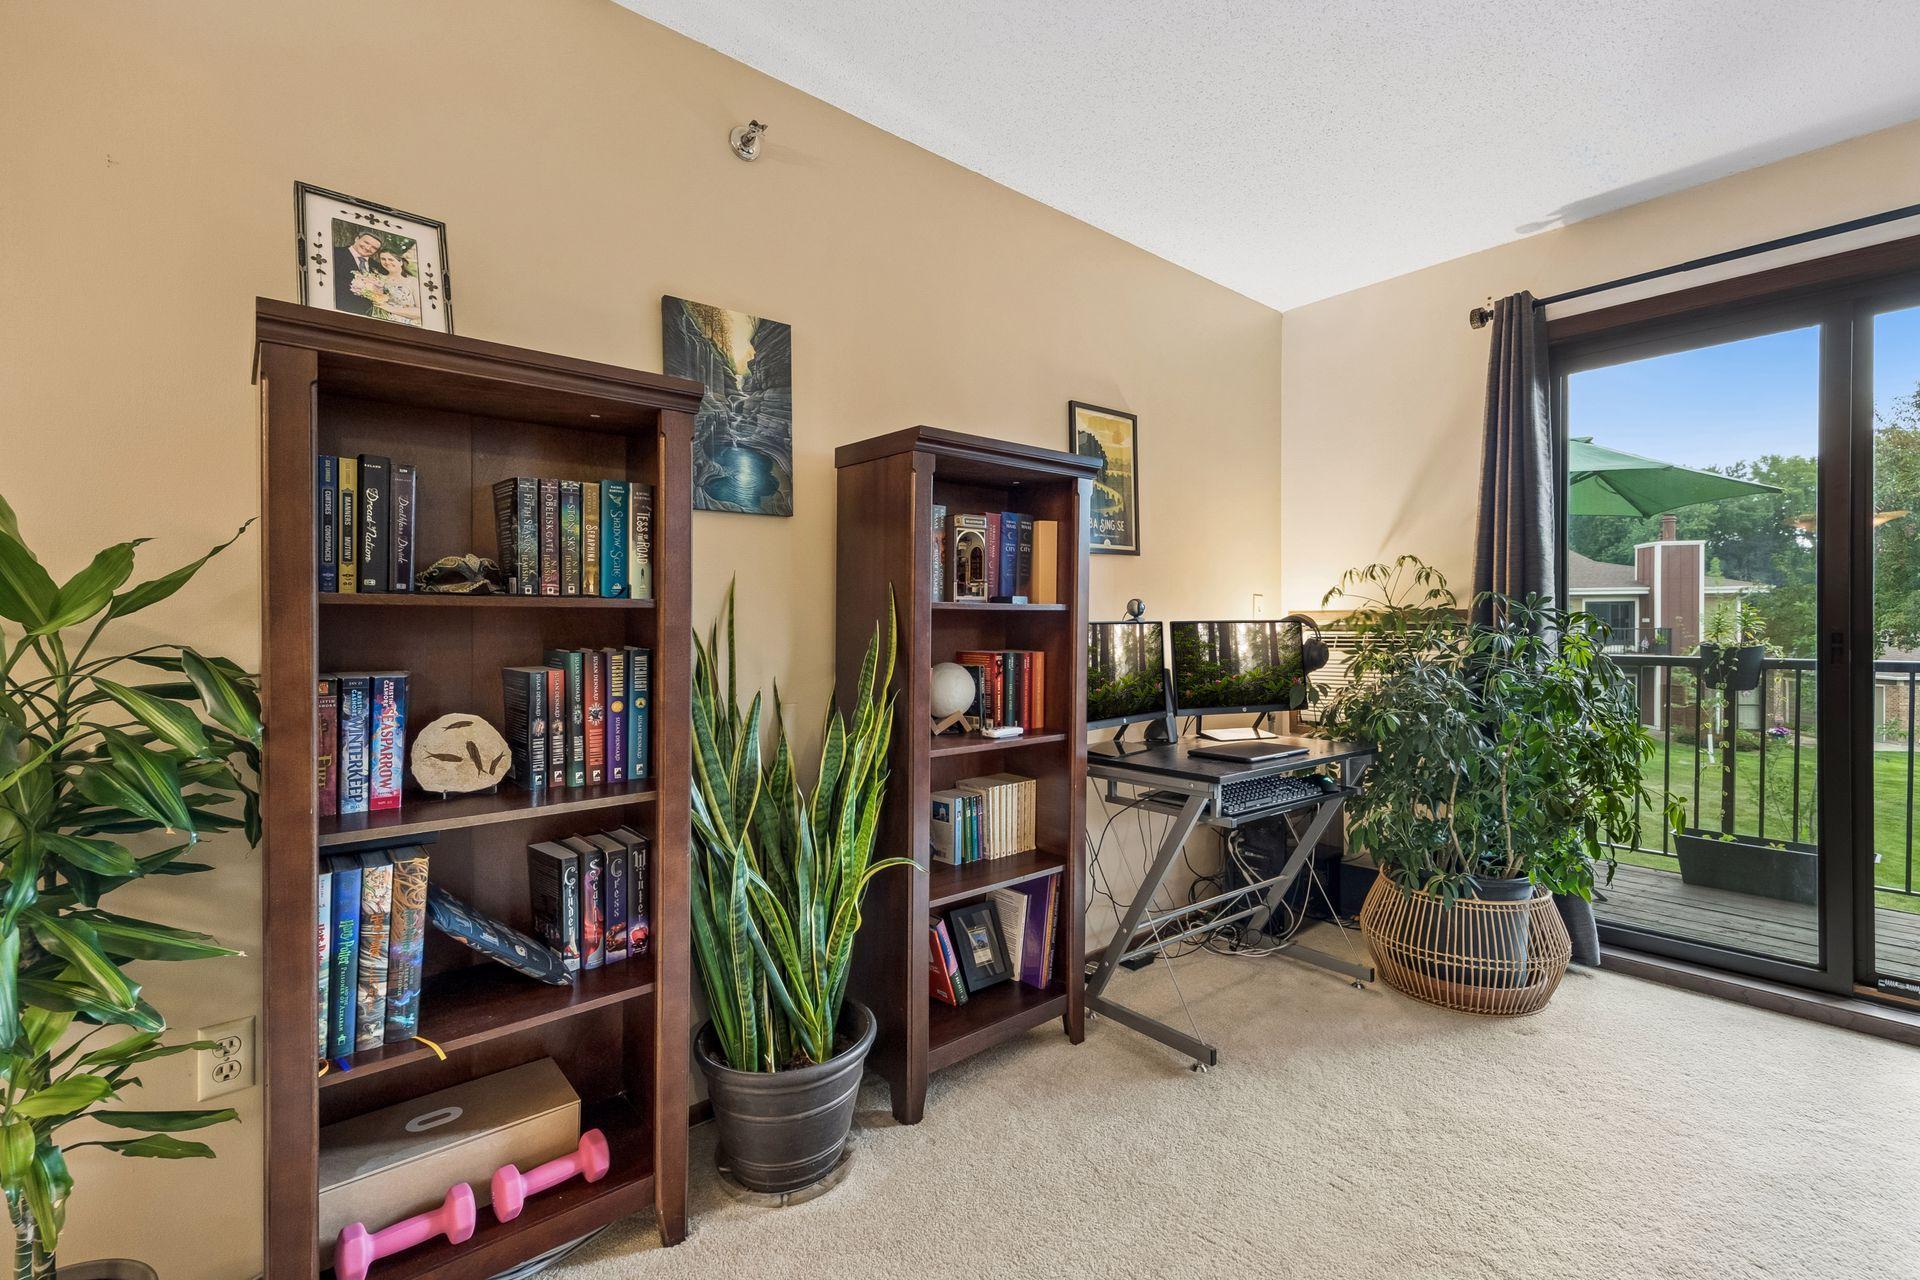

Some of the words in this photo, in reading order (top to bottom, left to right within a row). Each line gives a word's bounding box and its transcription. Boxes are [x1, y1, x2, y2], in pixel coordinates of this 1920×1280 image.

[365, 488, 379, 524] Dread
[524, 494, 532, 518] FIFTH
[545, 494, 554, 530] OBELISK
[567, 504, 576, 534] STONE
[636, 512, 650, 532] TESS
[524, 519, 532, 553] SEASON
[545, 531, 553, 552] GATE
[1089, 518, 1098, 528] BA
[1100, 518, 1116, 532] SING
[1116, 520, 1124, 532] SE
[364, 526, 377, 562] Nation
[567, 536, 576, 552] SKY
[586, 524, 598, 562] SERAPHINA
[636, 542, 650, 564] ROAD
[634, 656, 647, 692] WITCHLIGHT
[346, 716, 364, 803] WINTERKEEP
[378, 706, 394, 790] SEASPARROW
[564, 866, 578, 936] Cinder
[610, 858, 622, 918] Cress
[632, 850, 646, 923] Winter
[339, 920, 354, 940] Harry
[337, 941, 354, 966] Potter
